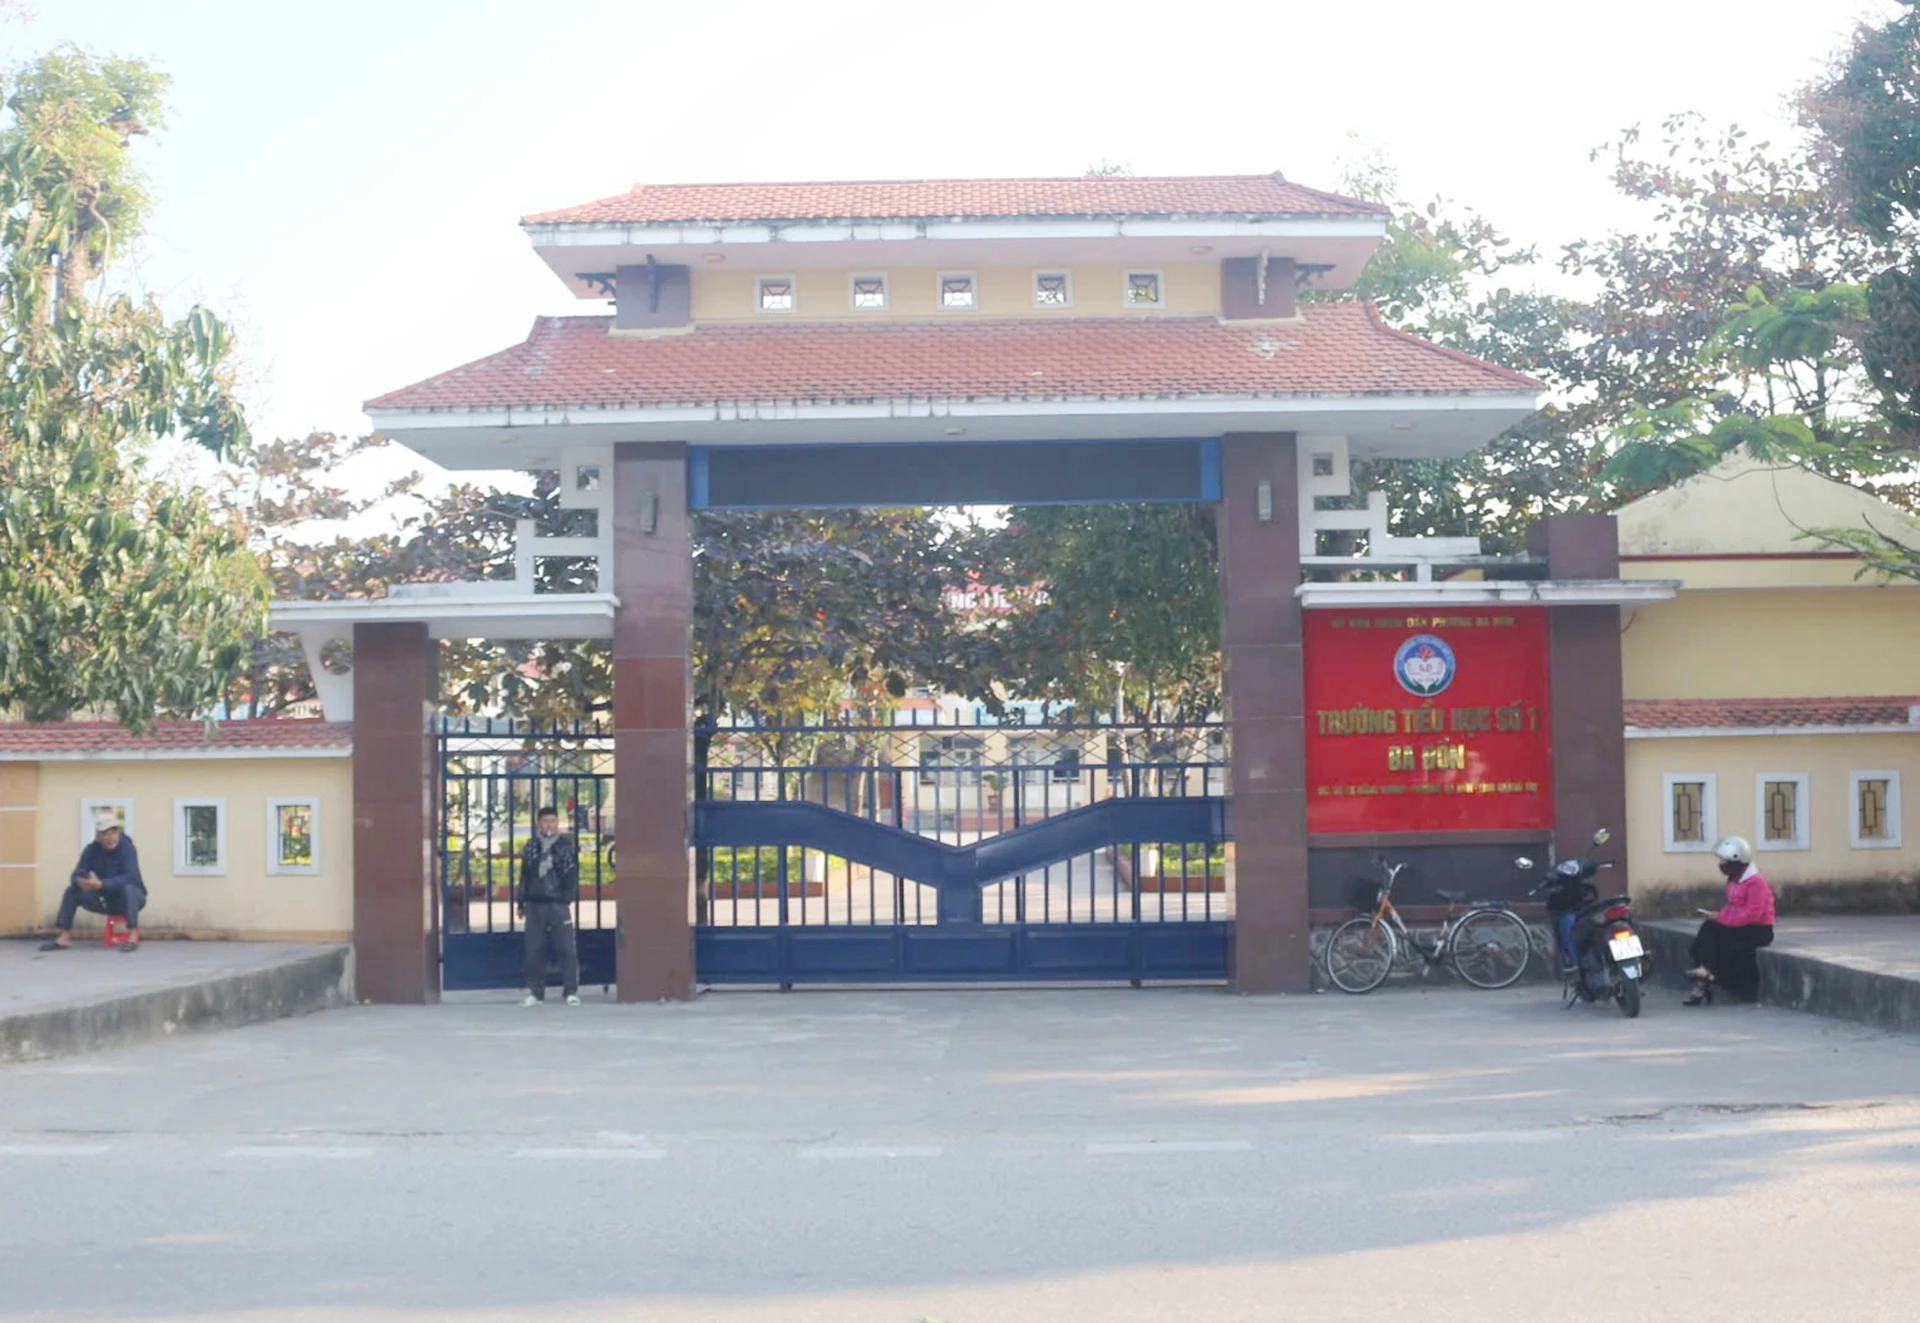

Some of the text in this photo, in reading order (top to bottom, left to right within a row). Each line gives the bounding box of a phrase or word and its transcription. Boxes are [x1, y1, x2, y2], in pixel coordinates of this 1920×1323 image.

[1316, 702, 1397, 735] TRƯỜNG
[1402, 700, 1444, 734] TIỂU
[1495, 700, 1525, 732] SỐ
[1528, 707, 1540, 732] 1
[1388, 745, 1415, 771] BA
